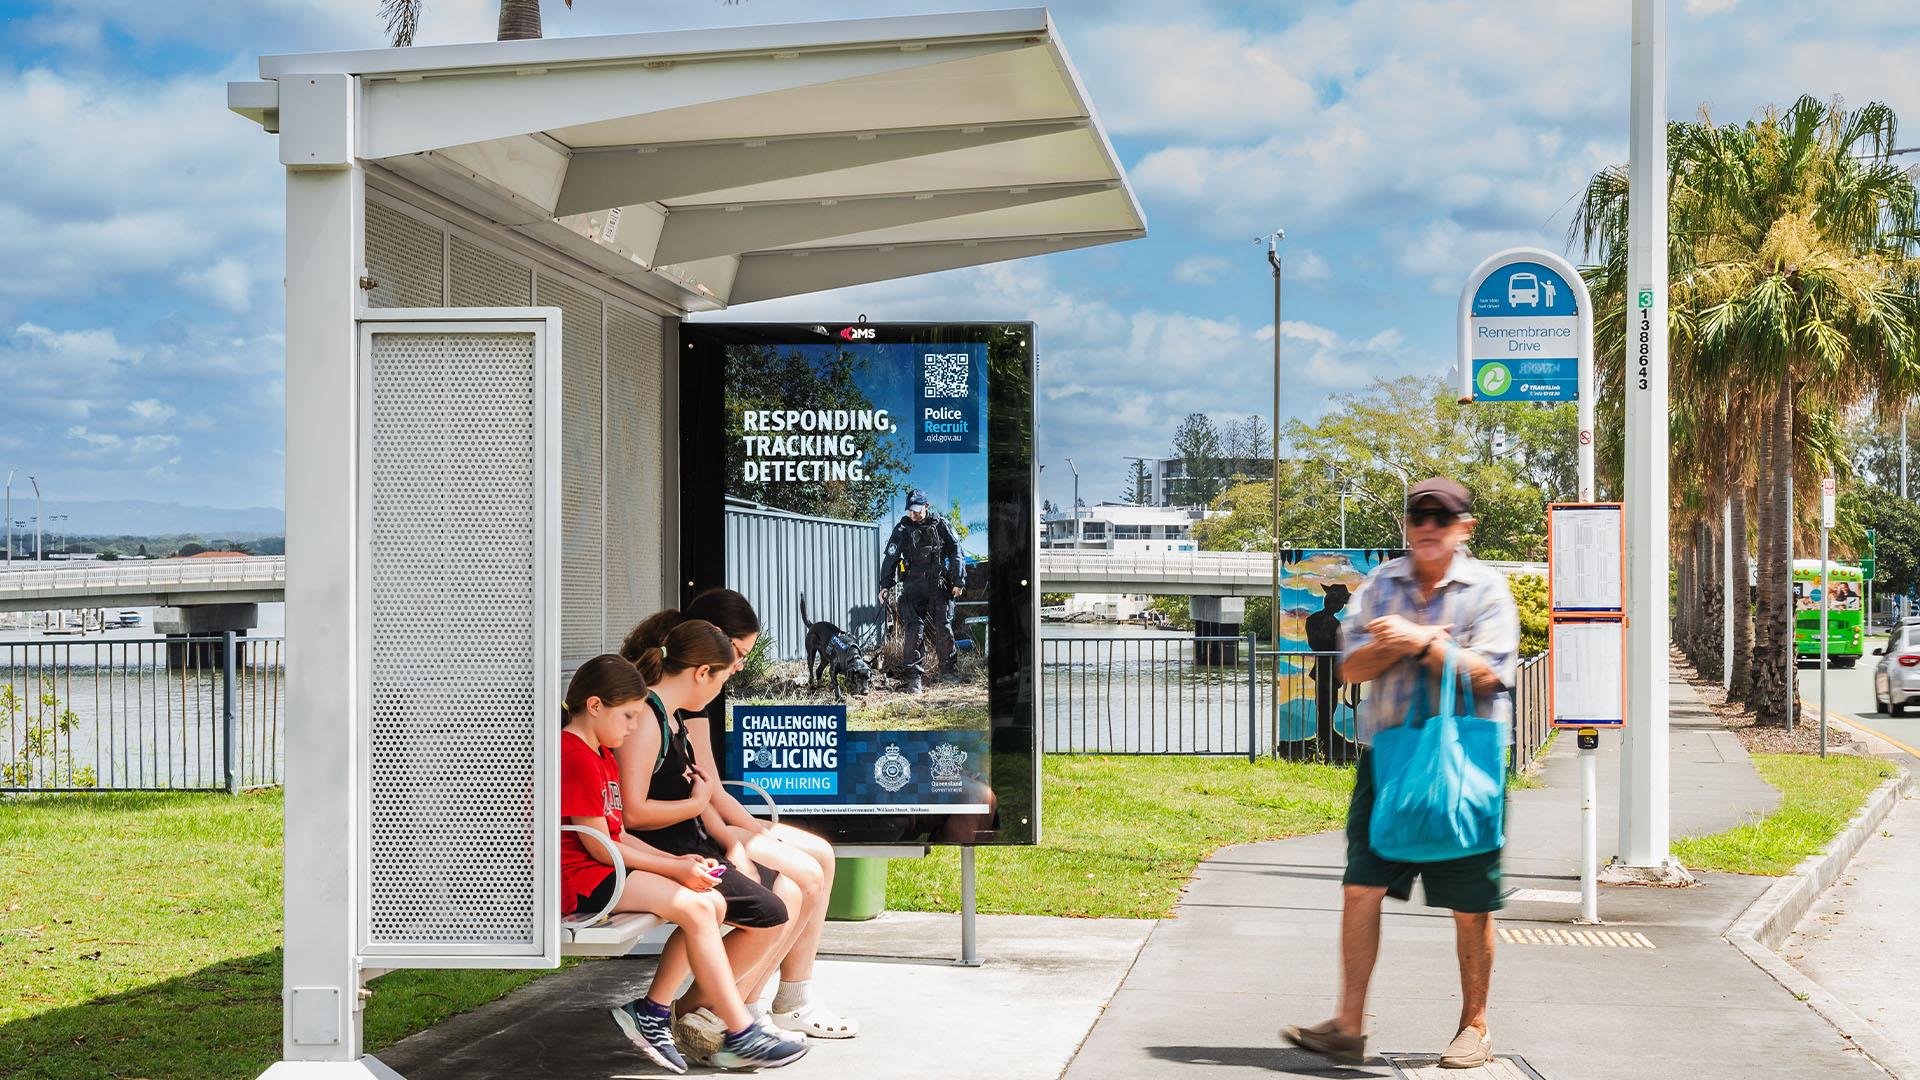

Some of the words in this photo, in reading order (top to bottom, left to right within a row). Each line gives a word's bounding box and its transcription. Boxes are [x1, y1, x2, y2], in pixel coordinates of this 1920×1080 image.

[848, 328, 876, 339] QMS
[1478, 326, 1571, 338] Remembrance
[1508, 339, 1541, 352] Drive
[925, 407, 962, 420] Police
[743, 410, 897, 434] RESPONDING,
[925, 420, 969, 433] Recruit
[925, 433, 962, 444] .qld.gov.au
[743, 435, 863, 459] TRACKING,
[744, 460, 871, 482] DETECTING.
[742, 715, 838, 730] CHALLENGING
[742, 731, 838, 747] REWARDING
[750, 777, 782, 790] NOW
[785, 777, 831, 790] HIRING
